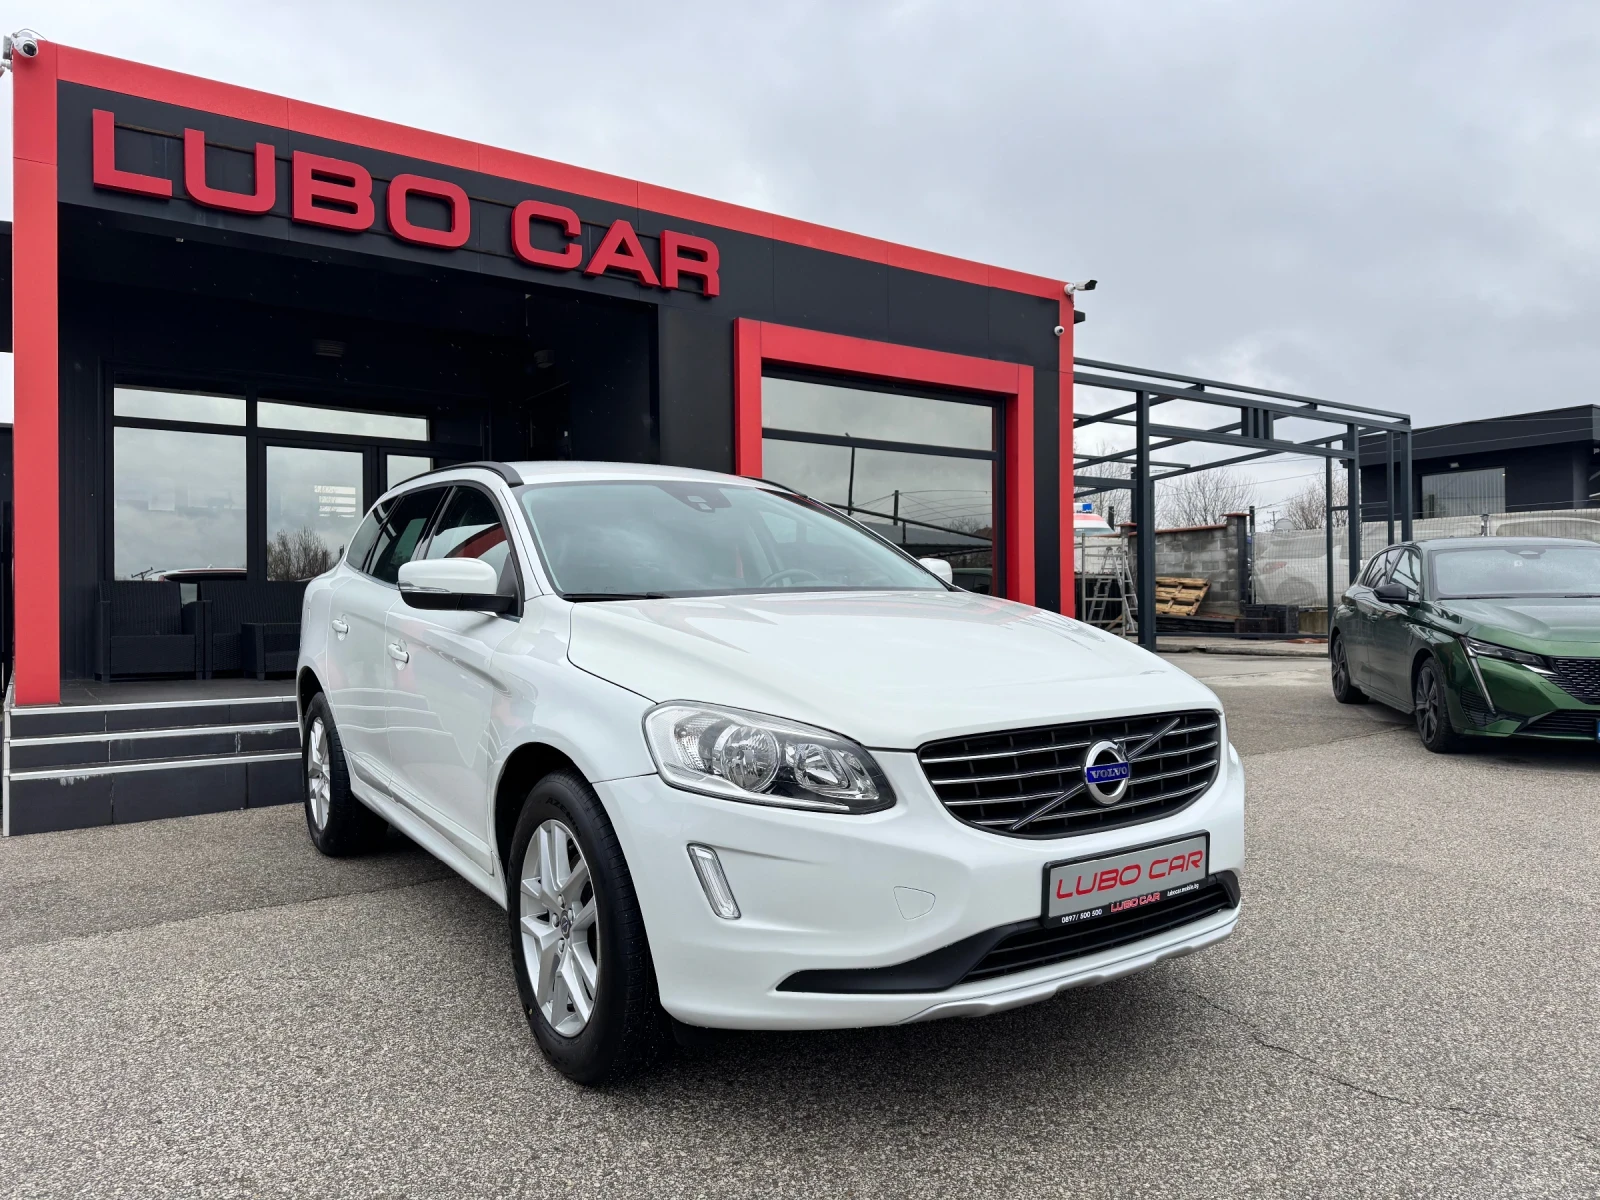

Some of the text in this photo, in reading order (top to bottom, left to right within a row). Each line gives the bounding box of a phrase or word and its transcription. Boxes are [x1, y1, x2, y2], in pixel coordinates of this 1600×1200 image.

[93, 110, 720, 297] LUBO CAR
[1090, 767, 1127, 778] VOLVO
[1057, 850, 1203, 899] LUBO CAR
[1110, 892, 1160, 912] LUBO CAR
[1061, 908, 1102, 923] 0897/ 500 500
